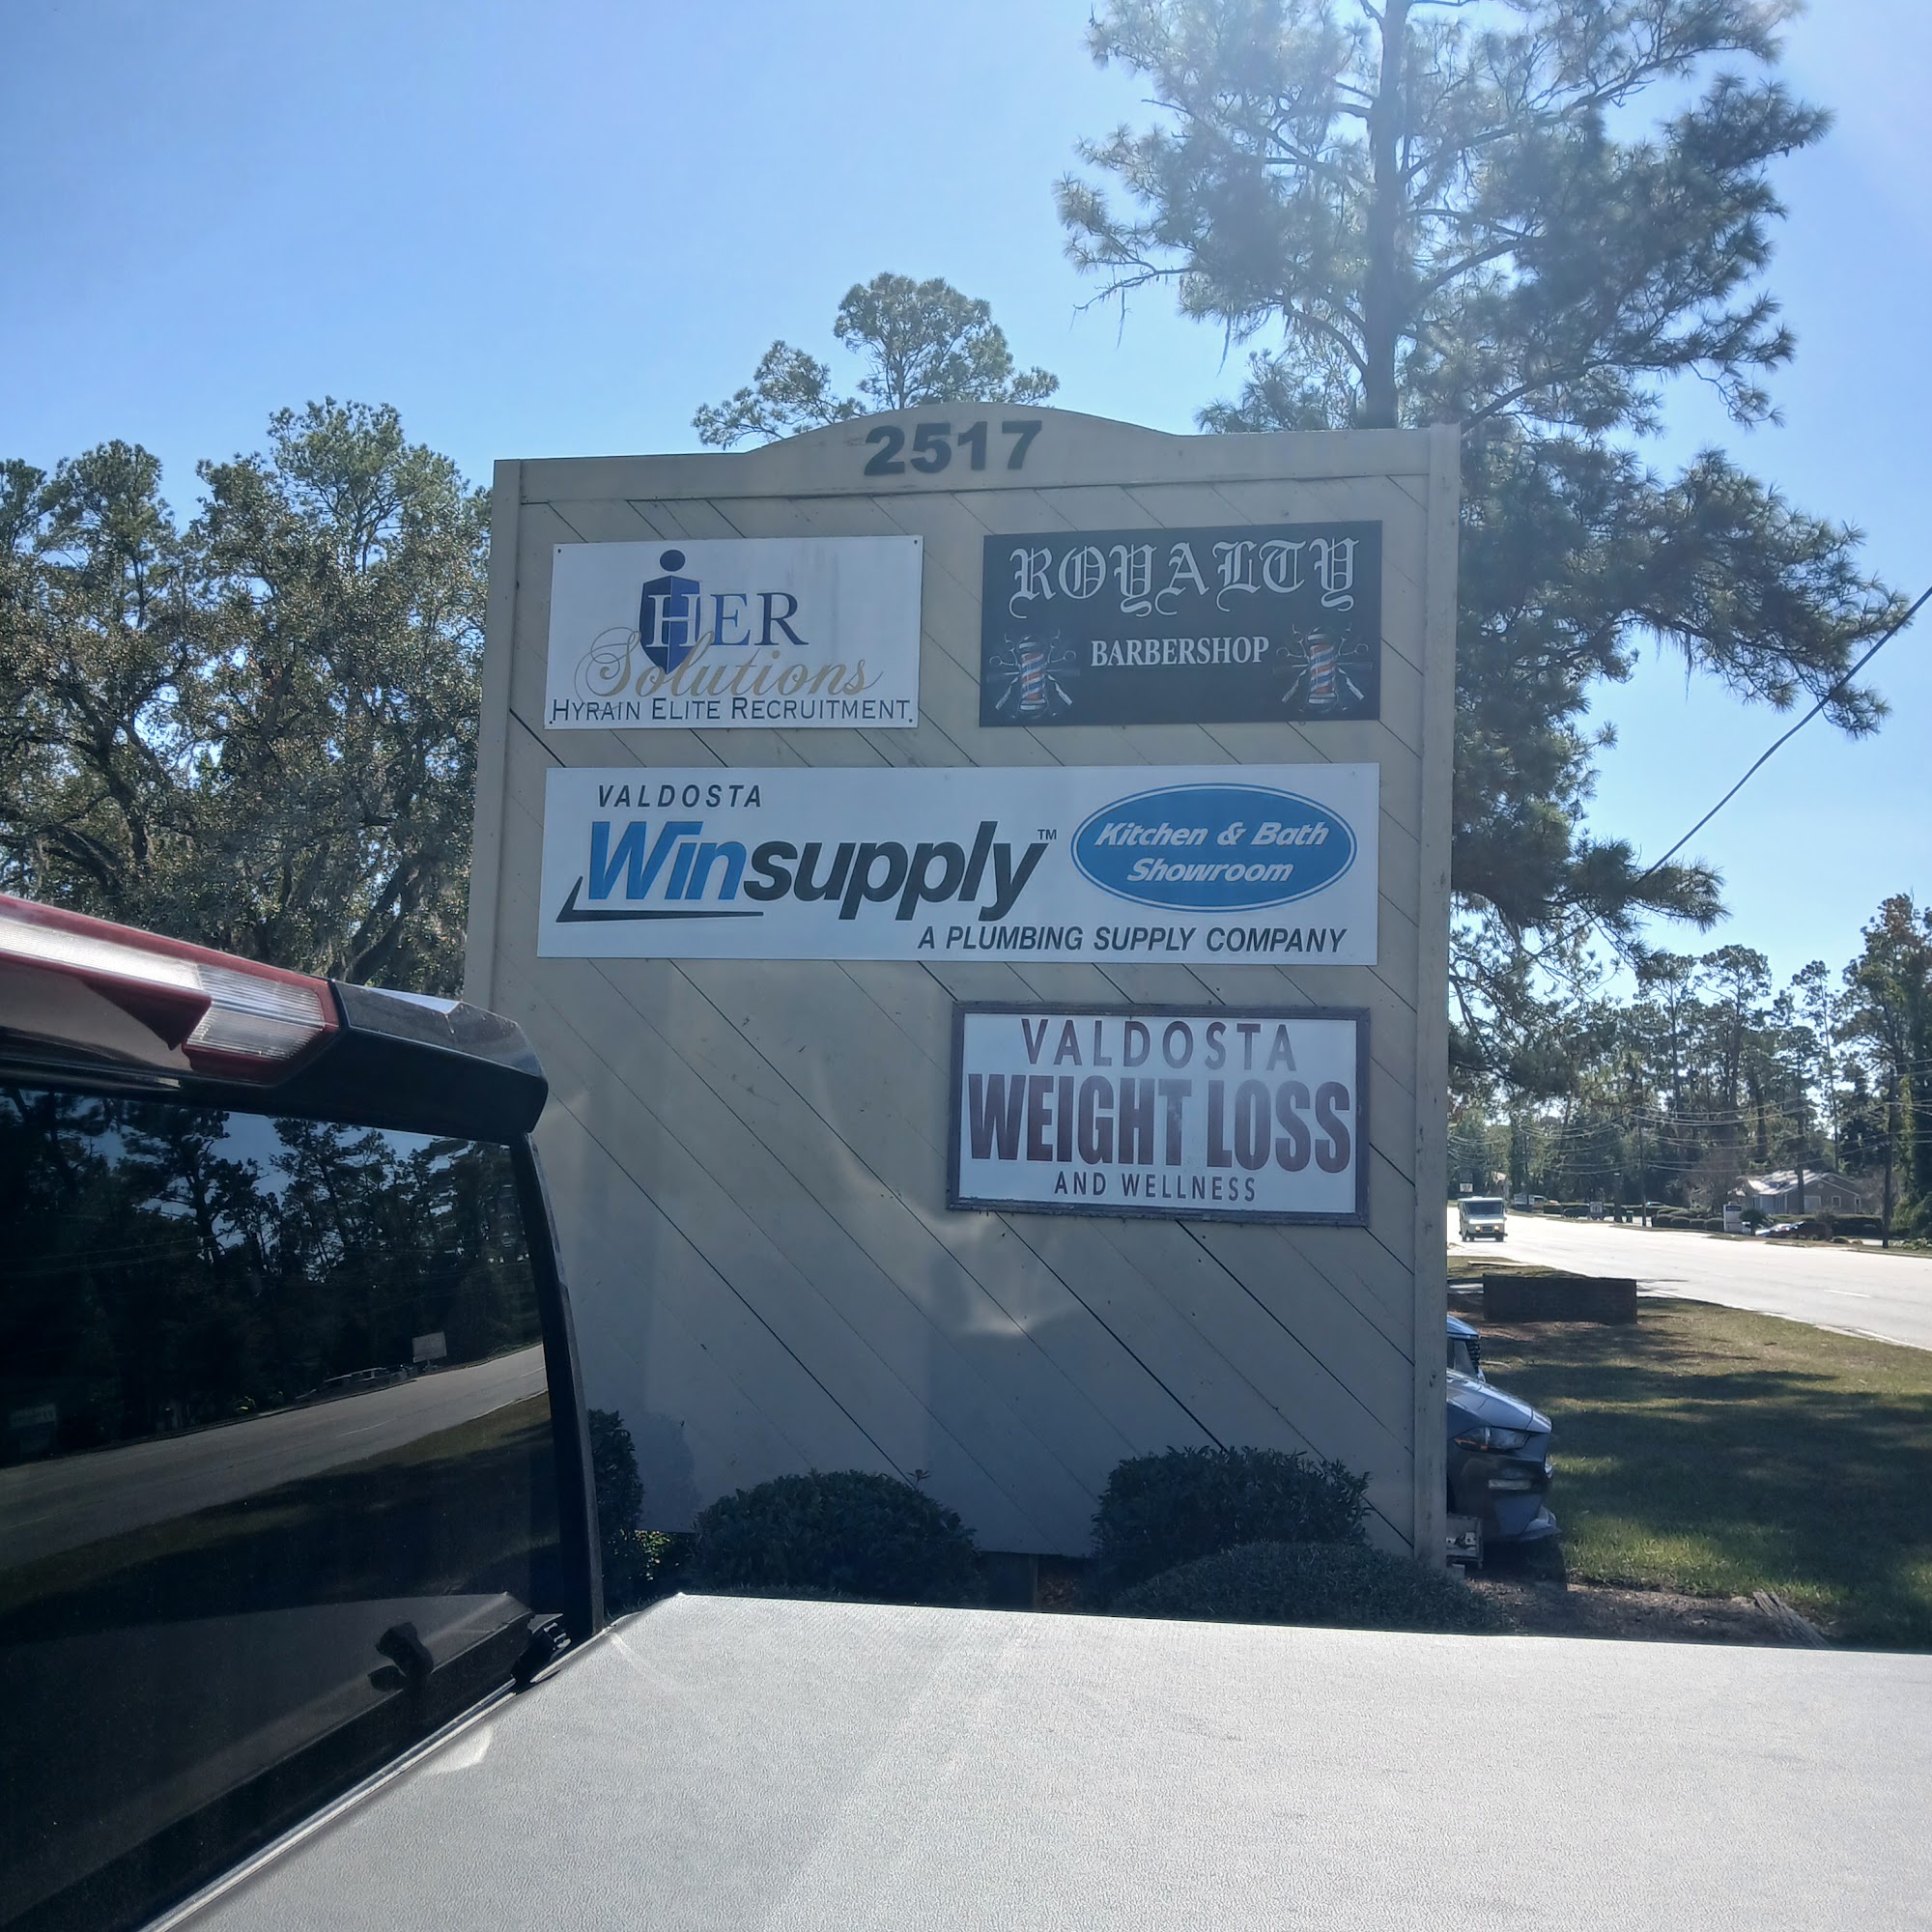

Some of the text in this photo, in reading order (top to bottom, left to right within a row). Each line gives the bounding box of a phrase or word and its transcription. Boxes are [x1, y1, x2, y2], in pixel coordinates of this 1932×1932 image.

[865, 420, 1042, 475] 2517
[1009, 537, 1359, 619] ROYALTY
[646, 592, 809, 648] HER
[575, 627, 883, 712] Solutions
[1091, 636, 1269, 667] BARBERSHOP
[553, 697, 910, 722] HYRAIN ELITE RECRUITMENT
[598, 784, 762, 808] VALDOSTA
[1094, 821, 1329, 847] Kitchen & Bath
[587, 820, 1049, 922] Winsupply
[1127, 858, 1294, 883] Showroom
[918, 925, 1348, 953] A PLUMBING SUPPLY COMPANY
[1021, 1018, 1296, 1071] VALDOSTA
[968, 1073, 1350, 1173] WEIGHT LOSS
[1054, 1170, 1256, 1201] AND WELLNESS
